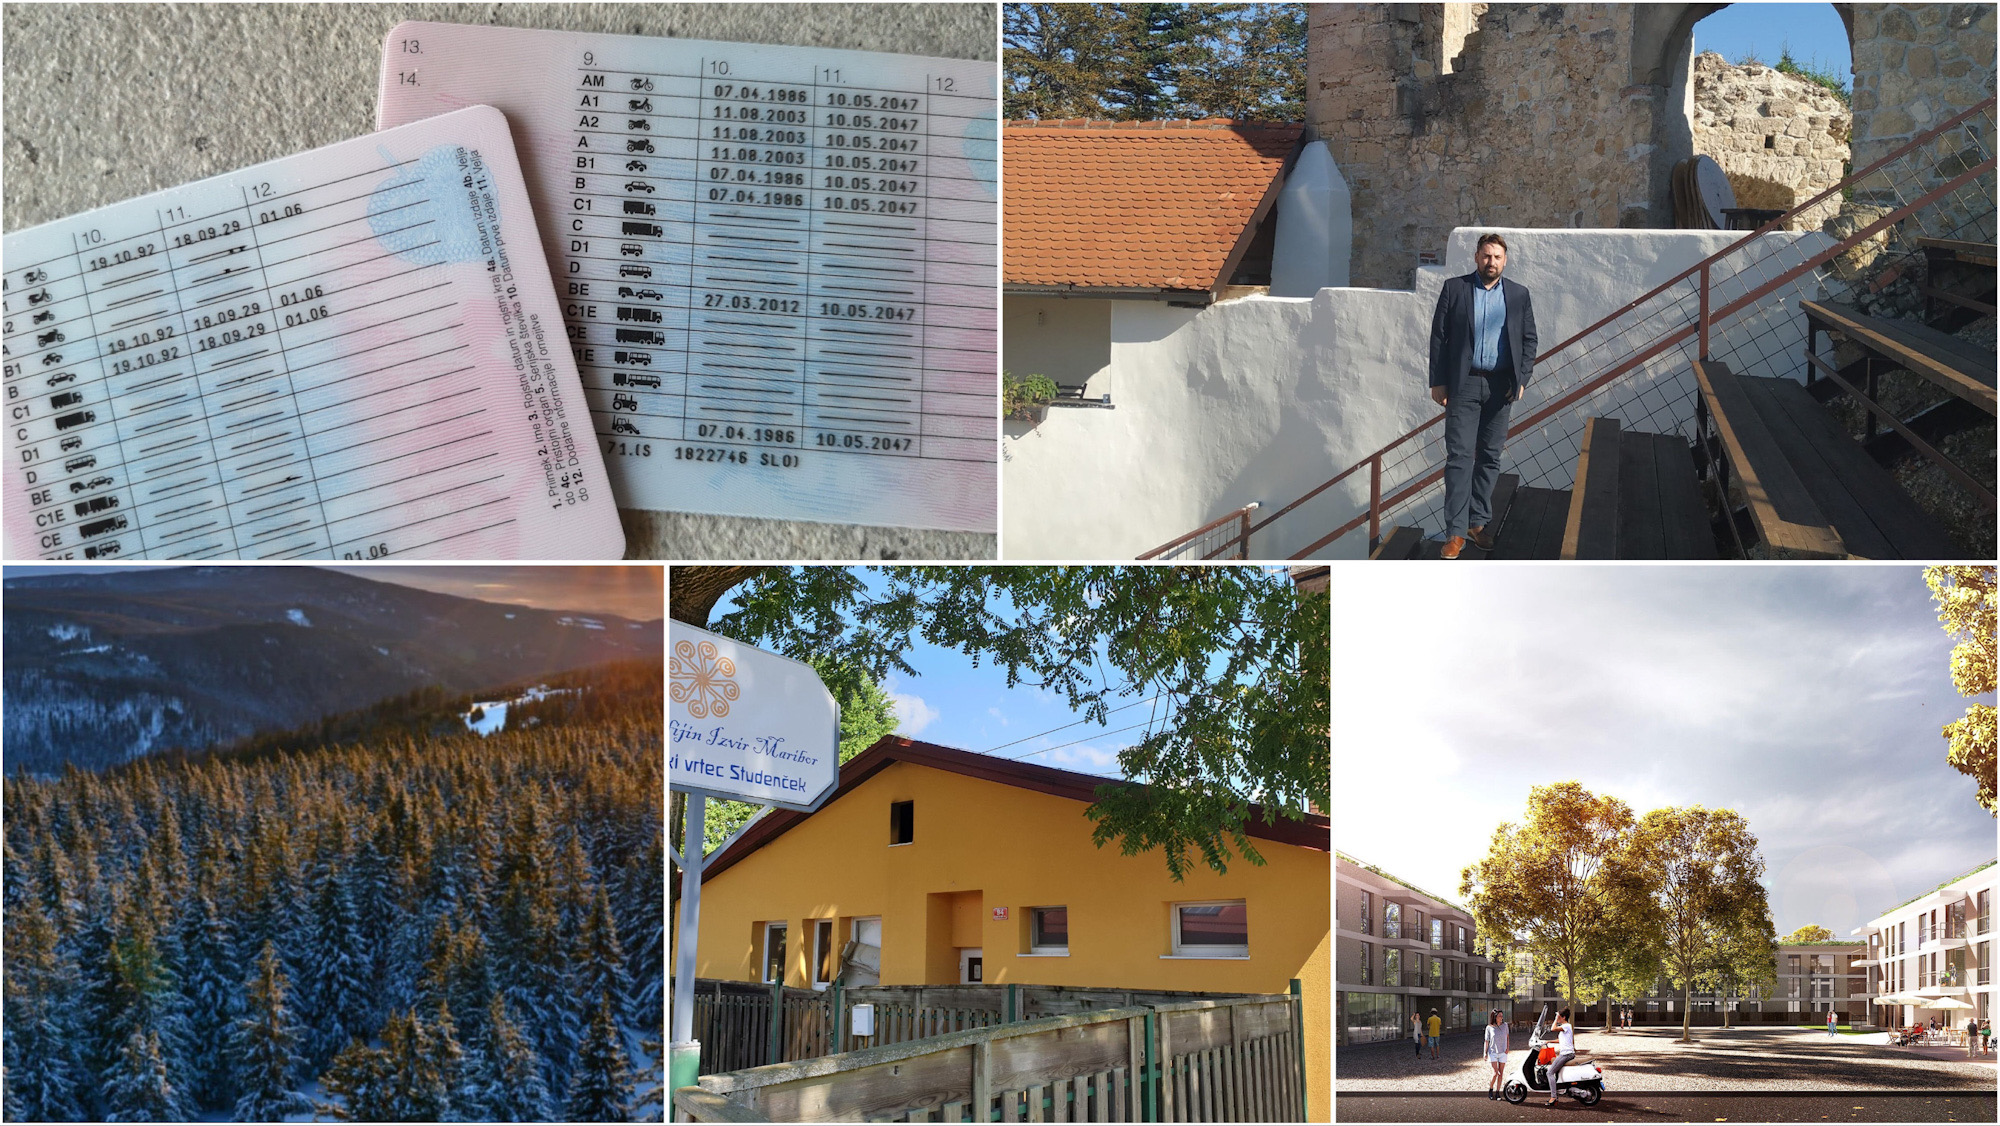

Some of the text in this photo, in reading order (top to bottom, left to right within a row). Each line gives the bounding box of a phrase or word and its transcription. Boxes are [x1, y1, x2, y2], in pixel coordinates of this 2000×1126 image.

[401, 39, 423, 54] 13.
[398, 72, 420, 87] 14.
[583, 51, 958, 92] 9. 10. 11. 12.
[581, 74, 919, 111] AM 07.04.1986 10.05.2047
[580, 94, 918, 131] A1 11.08.2003 10.05.2047
[579, 115, 918, 152] A2 11.08.2003 10.05.2047
[577, 135, 918, 173] A 11.08.2003 10.05.2047
[576, 156, 918, 194] B1 07.04.1986 10.05.2047
[573, 198, 592, 211] C1
[575, 177, 917, 215] B 07.04.1986 10.05.2047
[82, 182, 276, 245] 10. 11. 12.
[572, 219, 583, 231] C
[90, 203, 303, 272] 19.10.92 18.09.29 01.06
[571, 240, 589, 253] D1
[569, 261, 580, 273] D
[567, 304, 597, 318] C1E
[568, 282, 916, 321] BE 27.03.2012 10.05.2047
[3, 321, 14, 334] 2
[4, 285, 324, 378] B1 19.10.92 18.09.29 01.06
[456, 147, 562, 510] 1. Priimek 2. Ime 3. Rojstni datum in rojstni kraj 4a. Datum izdaje 4b. Velja
[470, 149, 576, 505] do 4c. Pristojni organ 5. Serijska številka 10. Datum prve izdaje 11. Velja
[530, 313, 548, 355] omejitve
[8, 305, 329, 399] B 19.10.92 18.09.29 01.06
[574, 349, 595, 362] 1E
[543, 363, 565, 419] informacije
[12, 405, 30, 420] C1
[17, 428, 28, 441] C
[561, 421, 579, 467] Dodatne
[698, 423, 913, 452] 07.04.1986 10.05.2047
[21, 448, 40, 463] D1
[675, 447, 748, 464] 1822746
[26, 471, 37, 484] D
[572, 468, 584, 485] 12.
[31, 489, 53, 506] BE
[579, 487, 589, 501] do
[36, 509, 66, 527] C1E
[41, 533, 63, 549] CE
[753, 736, 819, 766] Maribor
[685, 758, 724, 777] vrtec
[730, 764, 807, 793] Studenček
